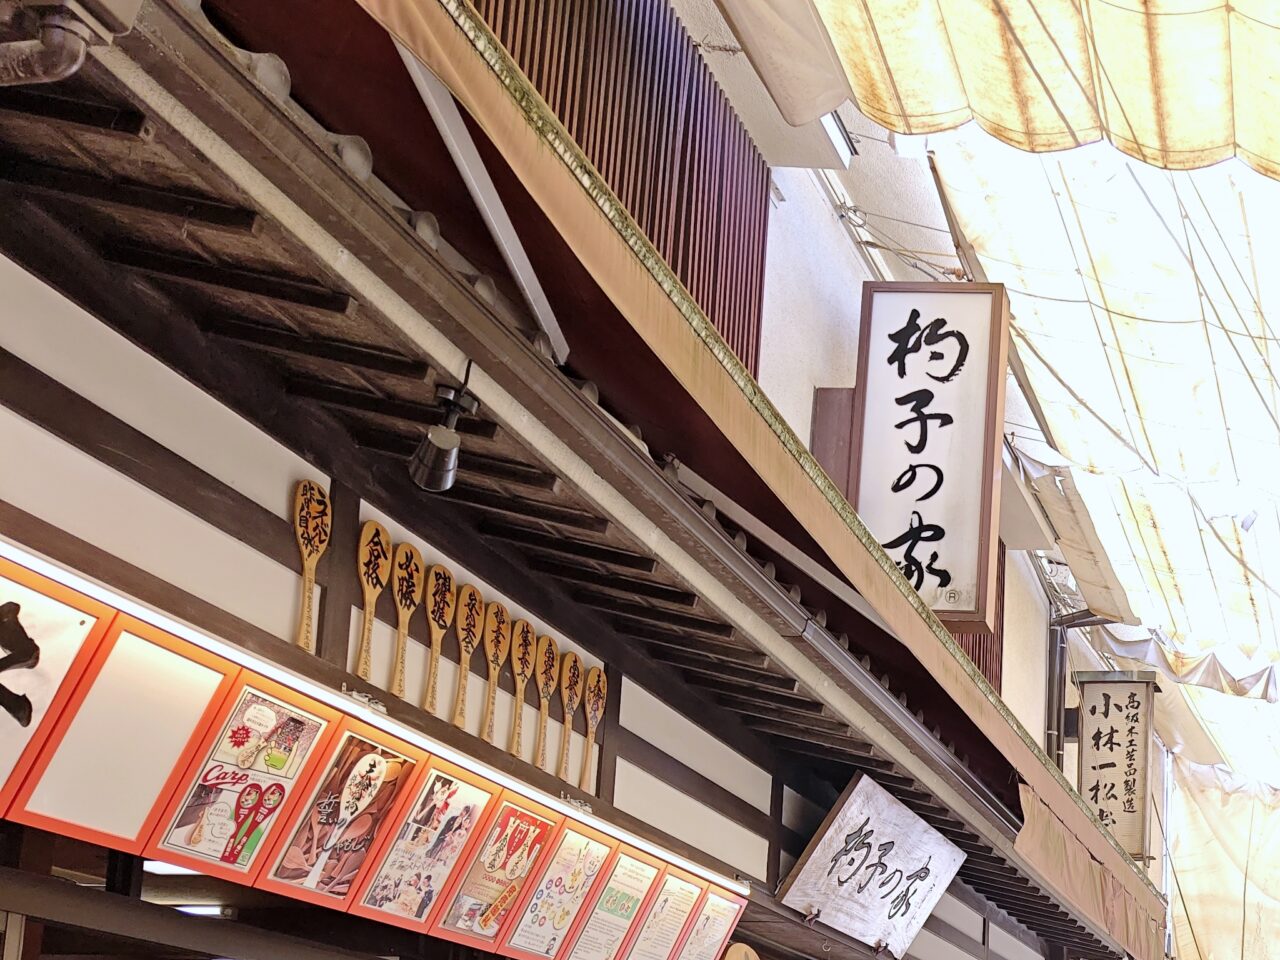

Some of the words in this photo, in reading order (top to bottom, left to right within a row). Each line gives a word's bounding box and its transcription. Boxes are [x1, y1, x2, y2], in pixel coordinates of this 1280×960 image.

[886, 308, 971, 589] 杓子の家
[363, 528, 389, 590] 合格
[397, 549, 420, 611] 必勝
[201, 764, 249, 788] Carp
[1122, 692, 1141, 813] 高級木工芸品製造
[827, 817, 932, 920] 杓子の家
